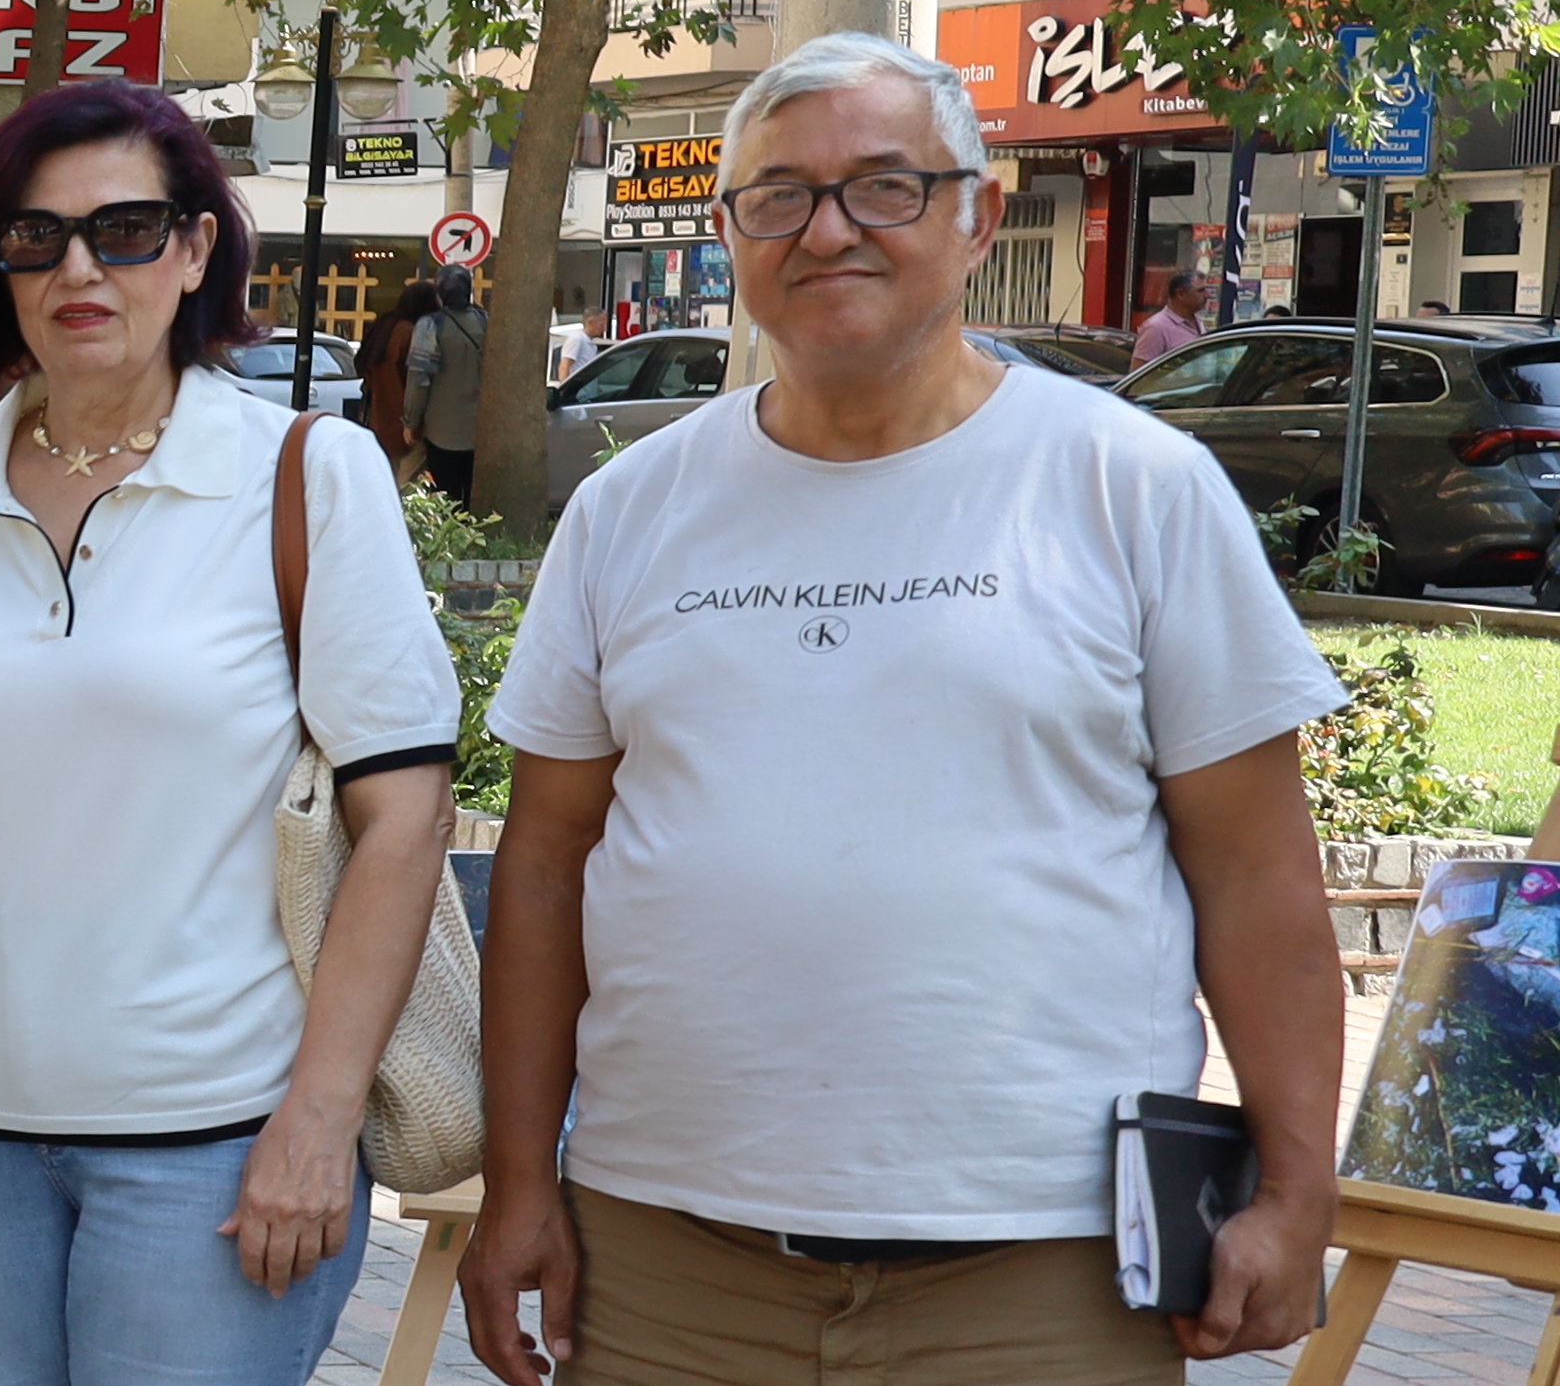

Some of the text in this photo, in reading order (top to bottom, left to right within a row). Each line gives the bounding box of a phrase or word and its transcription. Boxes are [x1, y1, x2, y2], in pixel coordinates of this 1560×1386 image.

[950, 63, 995, 87] ptan
[978, 118, 1007, 133] om.tr
[357, 136, 403, 149] TEKNO
[616, 174, 718, 201] BİLGİSAY
[674, 573, 999, 614] CALVIN KLEIN JEANS
